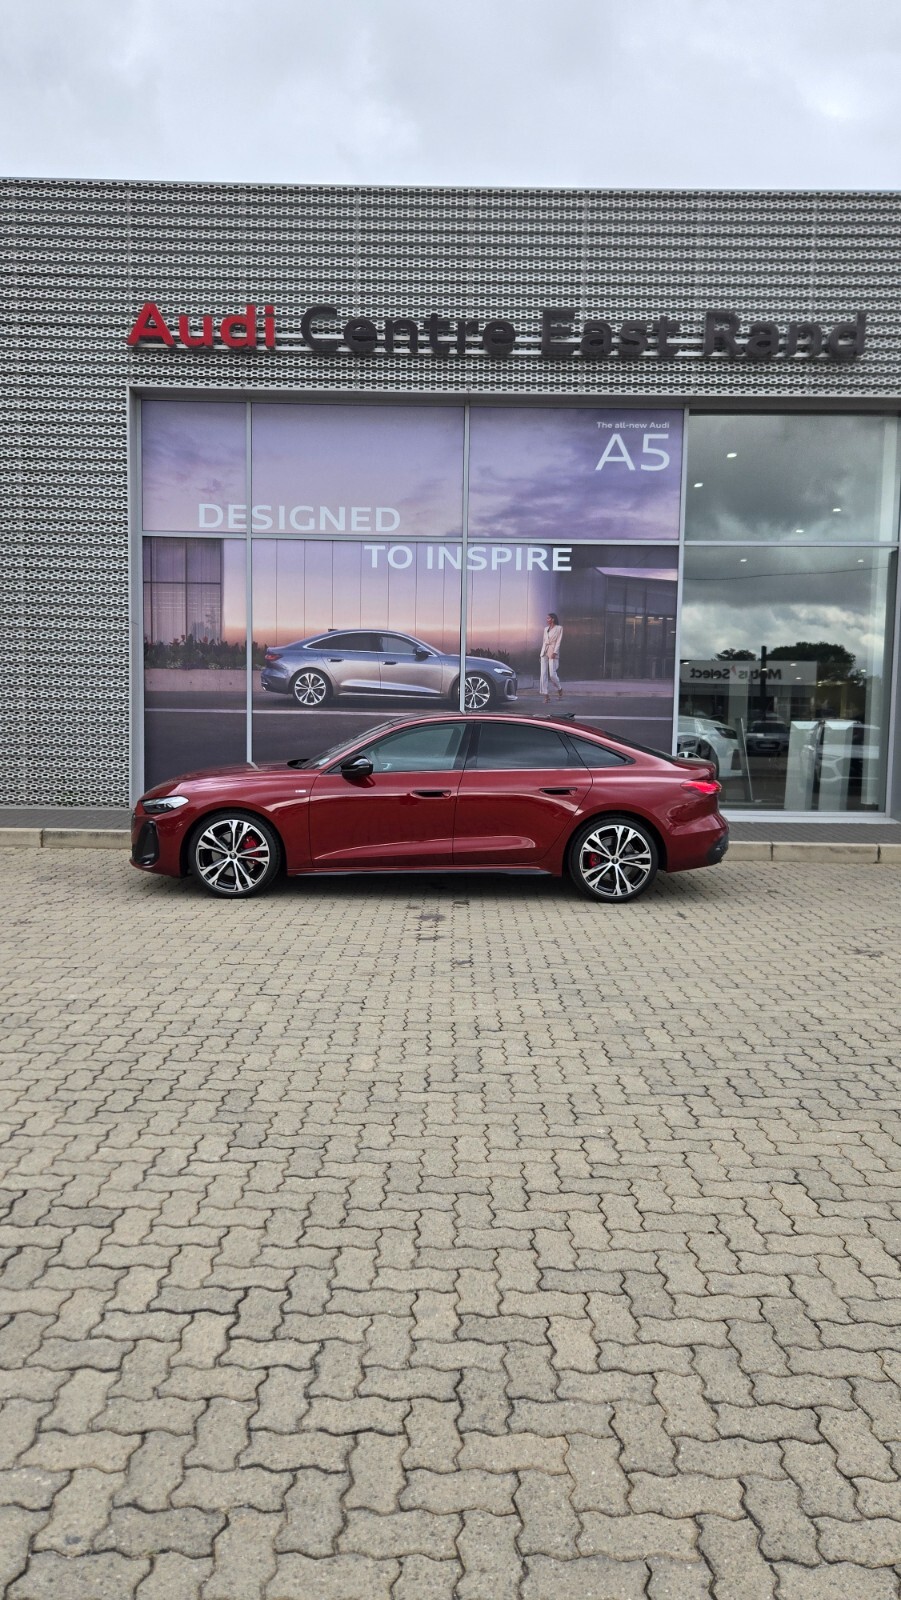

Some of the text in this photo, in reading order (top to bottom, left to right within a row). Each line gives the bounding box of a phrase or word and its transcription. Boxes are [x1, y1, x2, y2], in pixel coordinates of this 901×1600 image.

[127, 302, 867, 363] Audi Centre East Rand
[595, 433, 670, 471] A5
[198, 503, 401, 533] DESIGNED
[364, 545, 572, 572] TO INSPIRE
